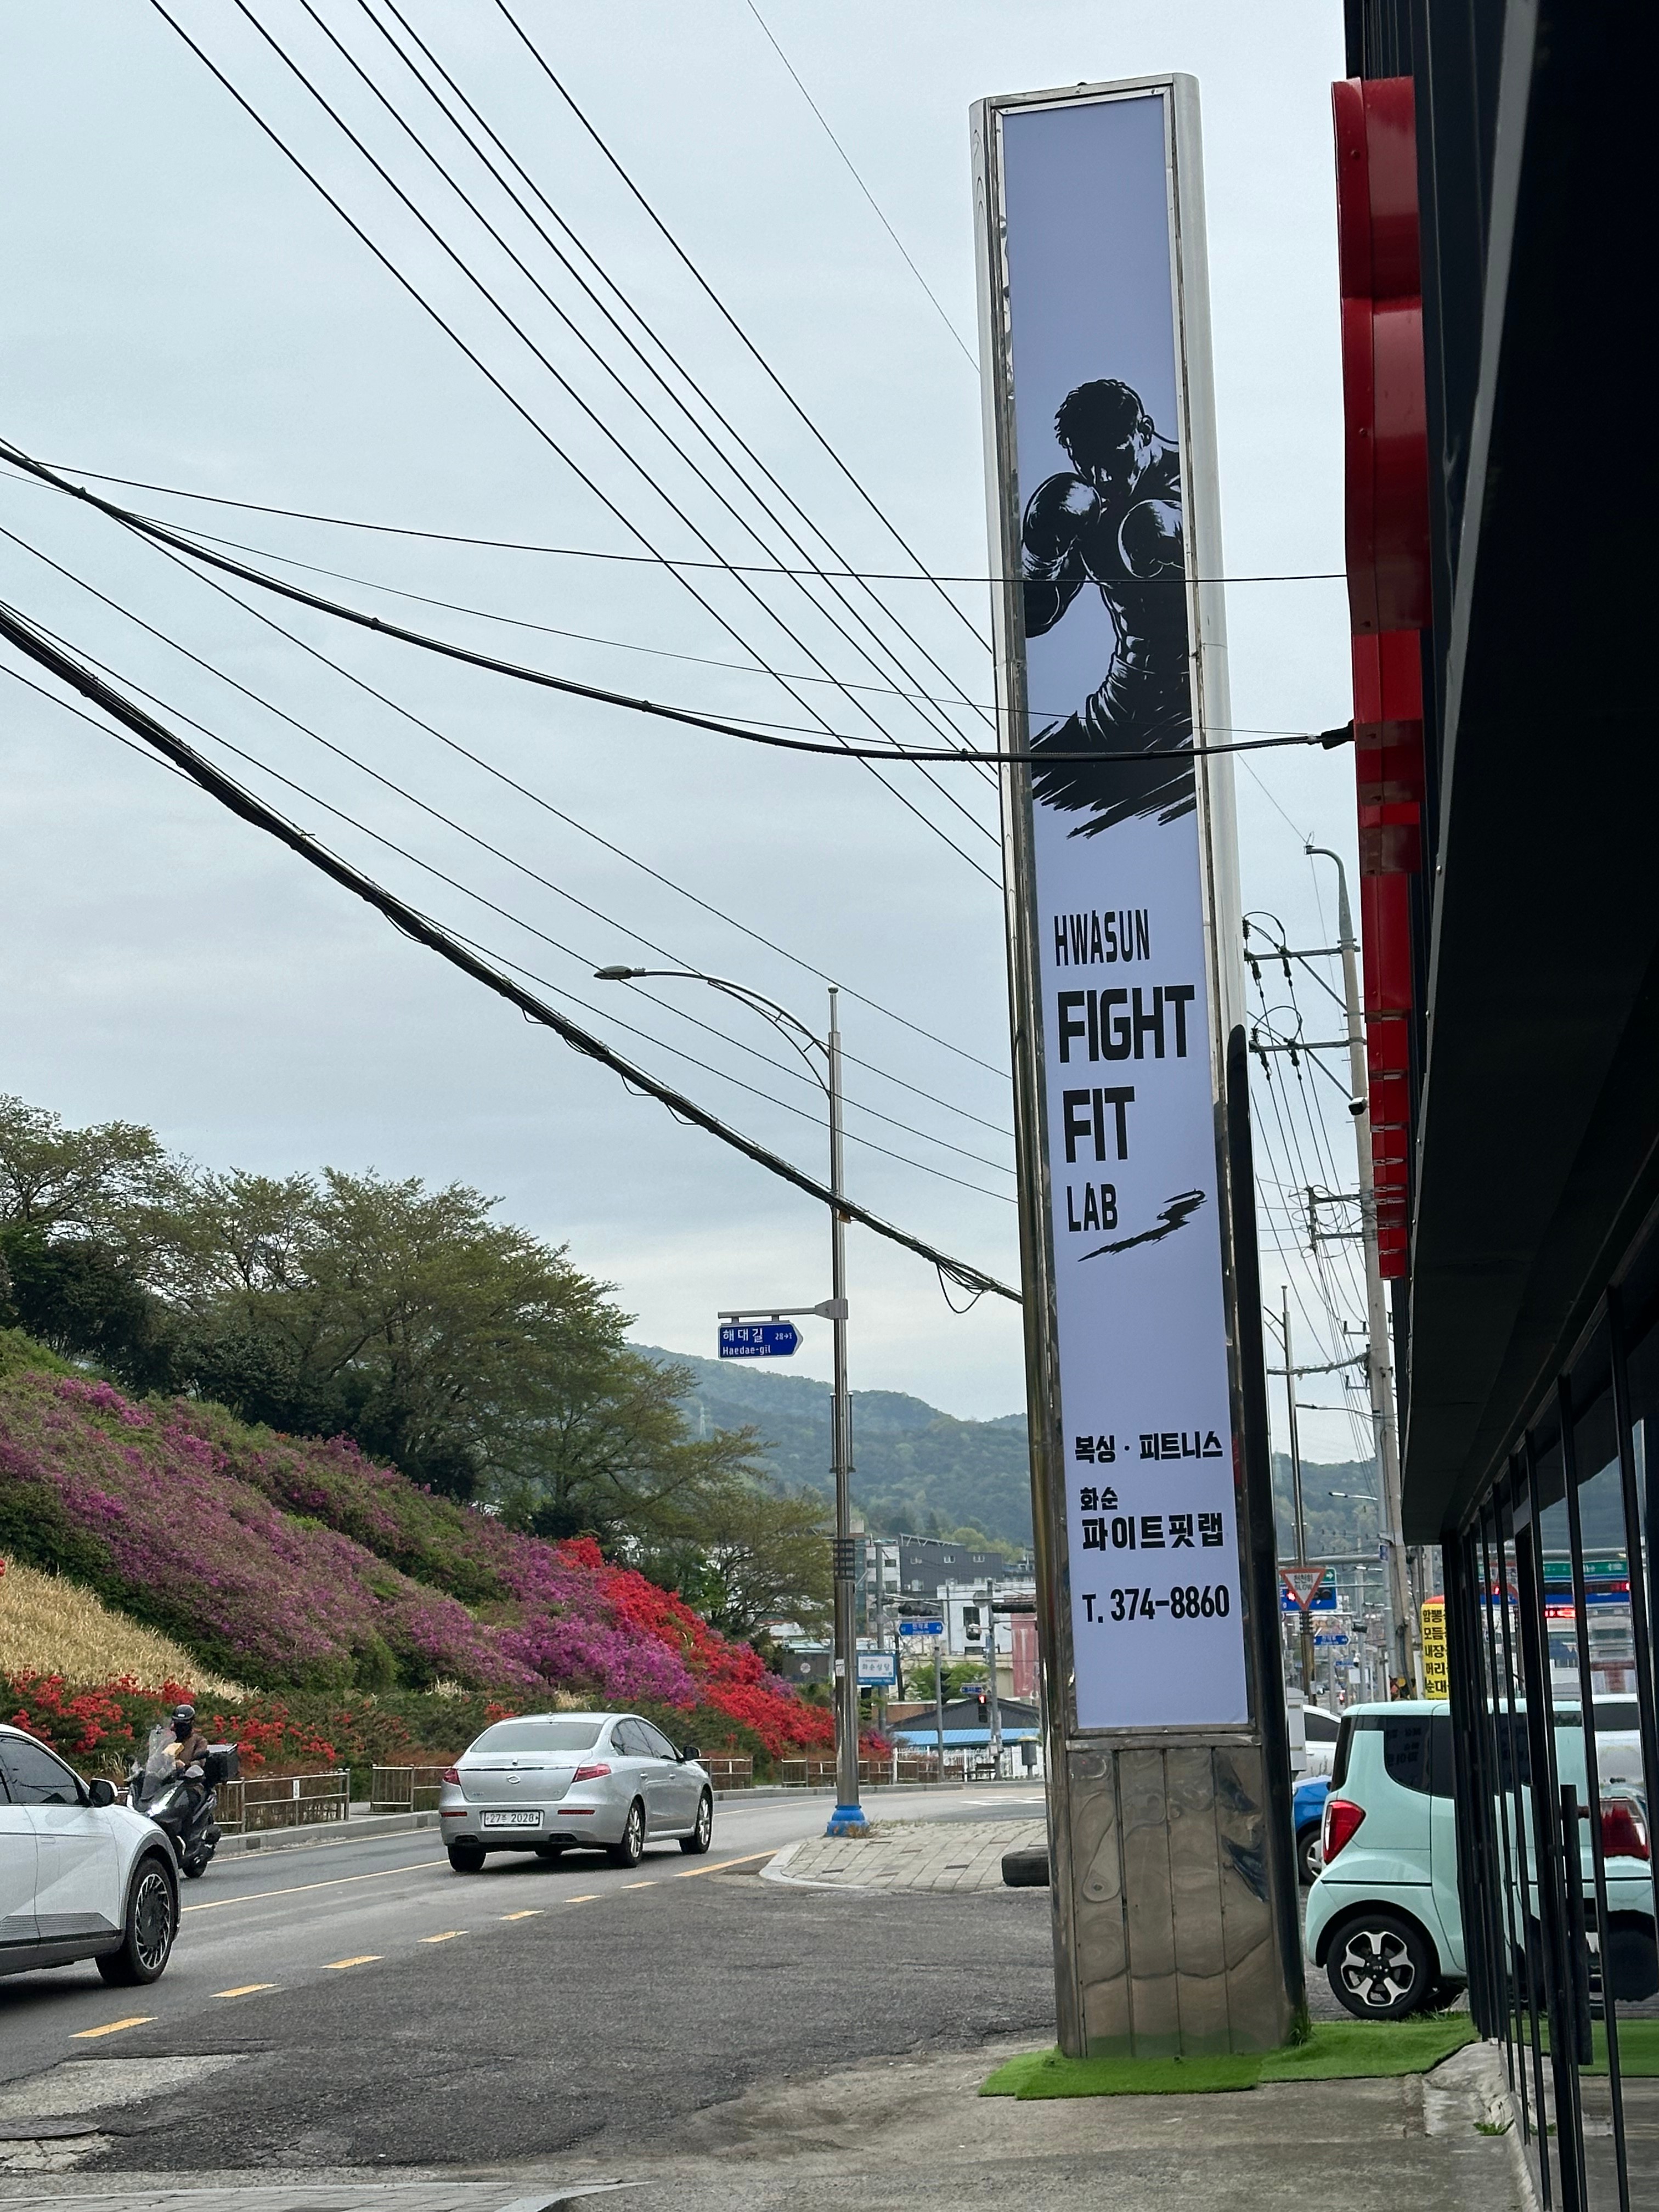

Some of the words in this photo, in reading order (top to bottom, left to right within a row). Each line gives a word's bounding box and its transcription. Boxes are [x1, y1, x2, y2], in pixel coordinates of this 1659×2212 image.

[1054, 909, 1150, 967] HWASUN
[1057, 984, 1195, 1063] FIGHT
[1063, 1086, 1135, 1164] FIT
[1066, 1182, 1118, 1232] LAB
[723, 1328, 763, 1343] 해대길
[1075, 1435, 1116, 1464] 복싱
[1139, 1430, 1223, 1461] 피트니스
[1080, 1486, 1118, 1511] 화순
[1081, 1512, 1223, 1551] 파이트핏랩
[1294, 1573, 1313, 1583] 천천히
[1110, 1584, 1230, 1622] 374-8860
[1423, 1609, 1445, 1623] 암뽕
[1424, 1627, 1446, 1640] 모듬
[1425, 1645, 1447, 1658] 내장
[511, 1813, 534, 1822] 2028
